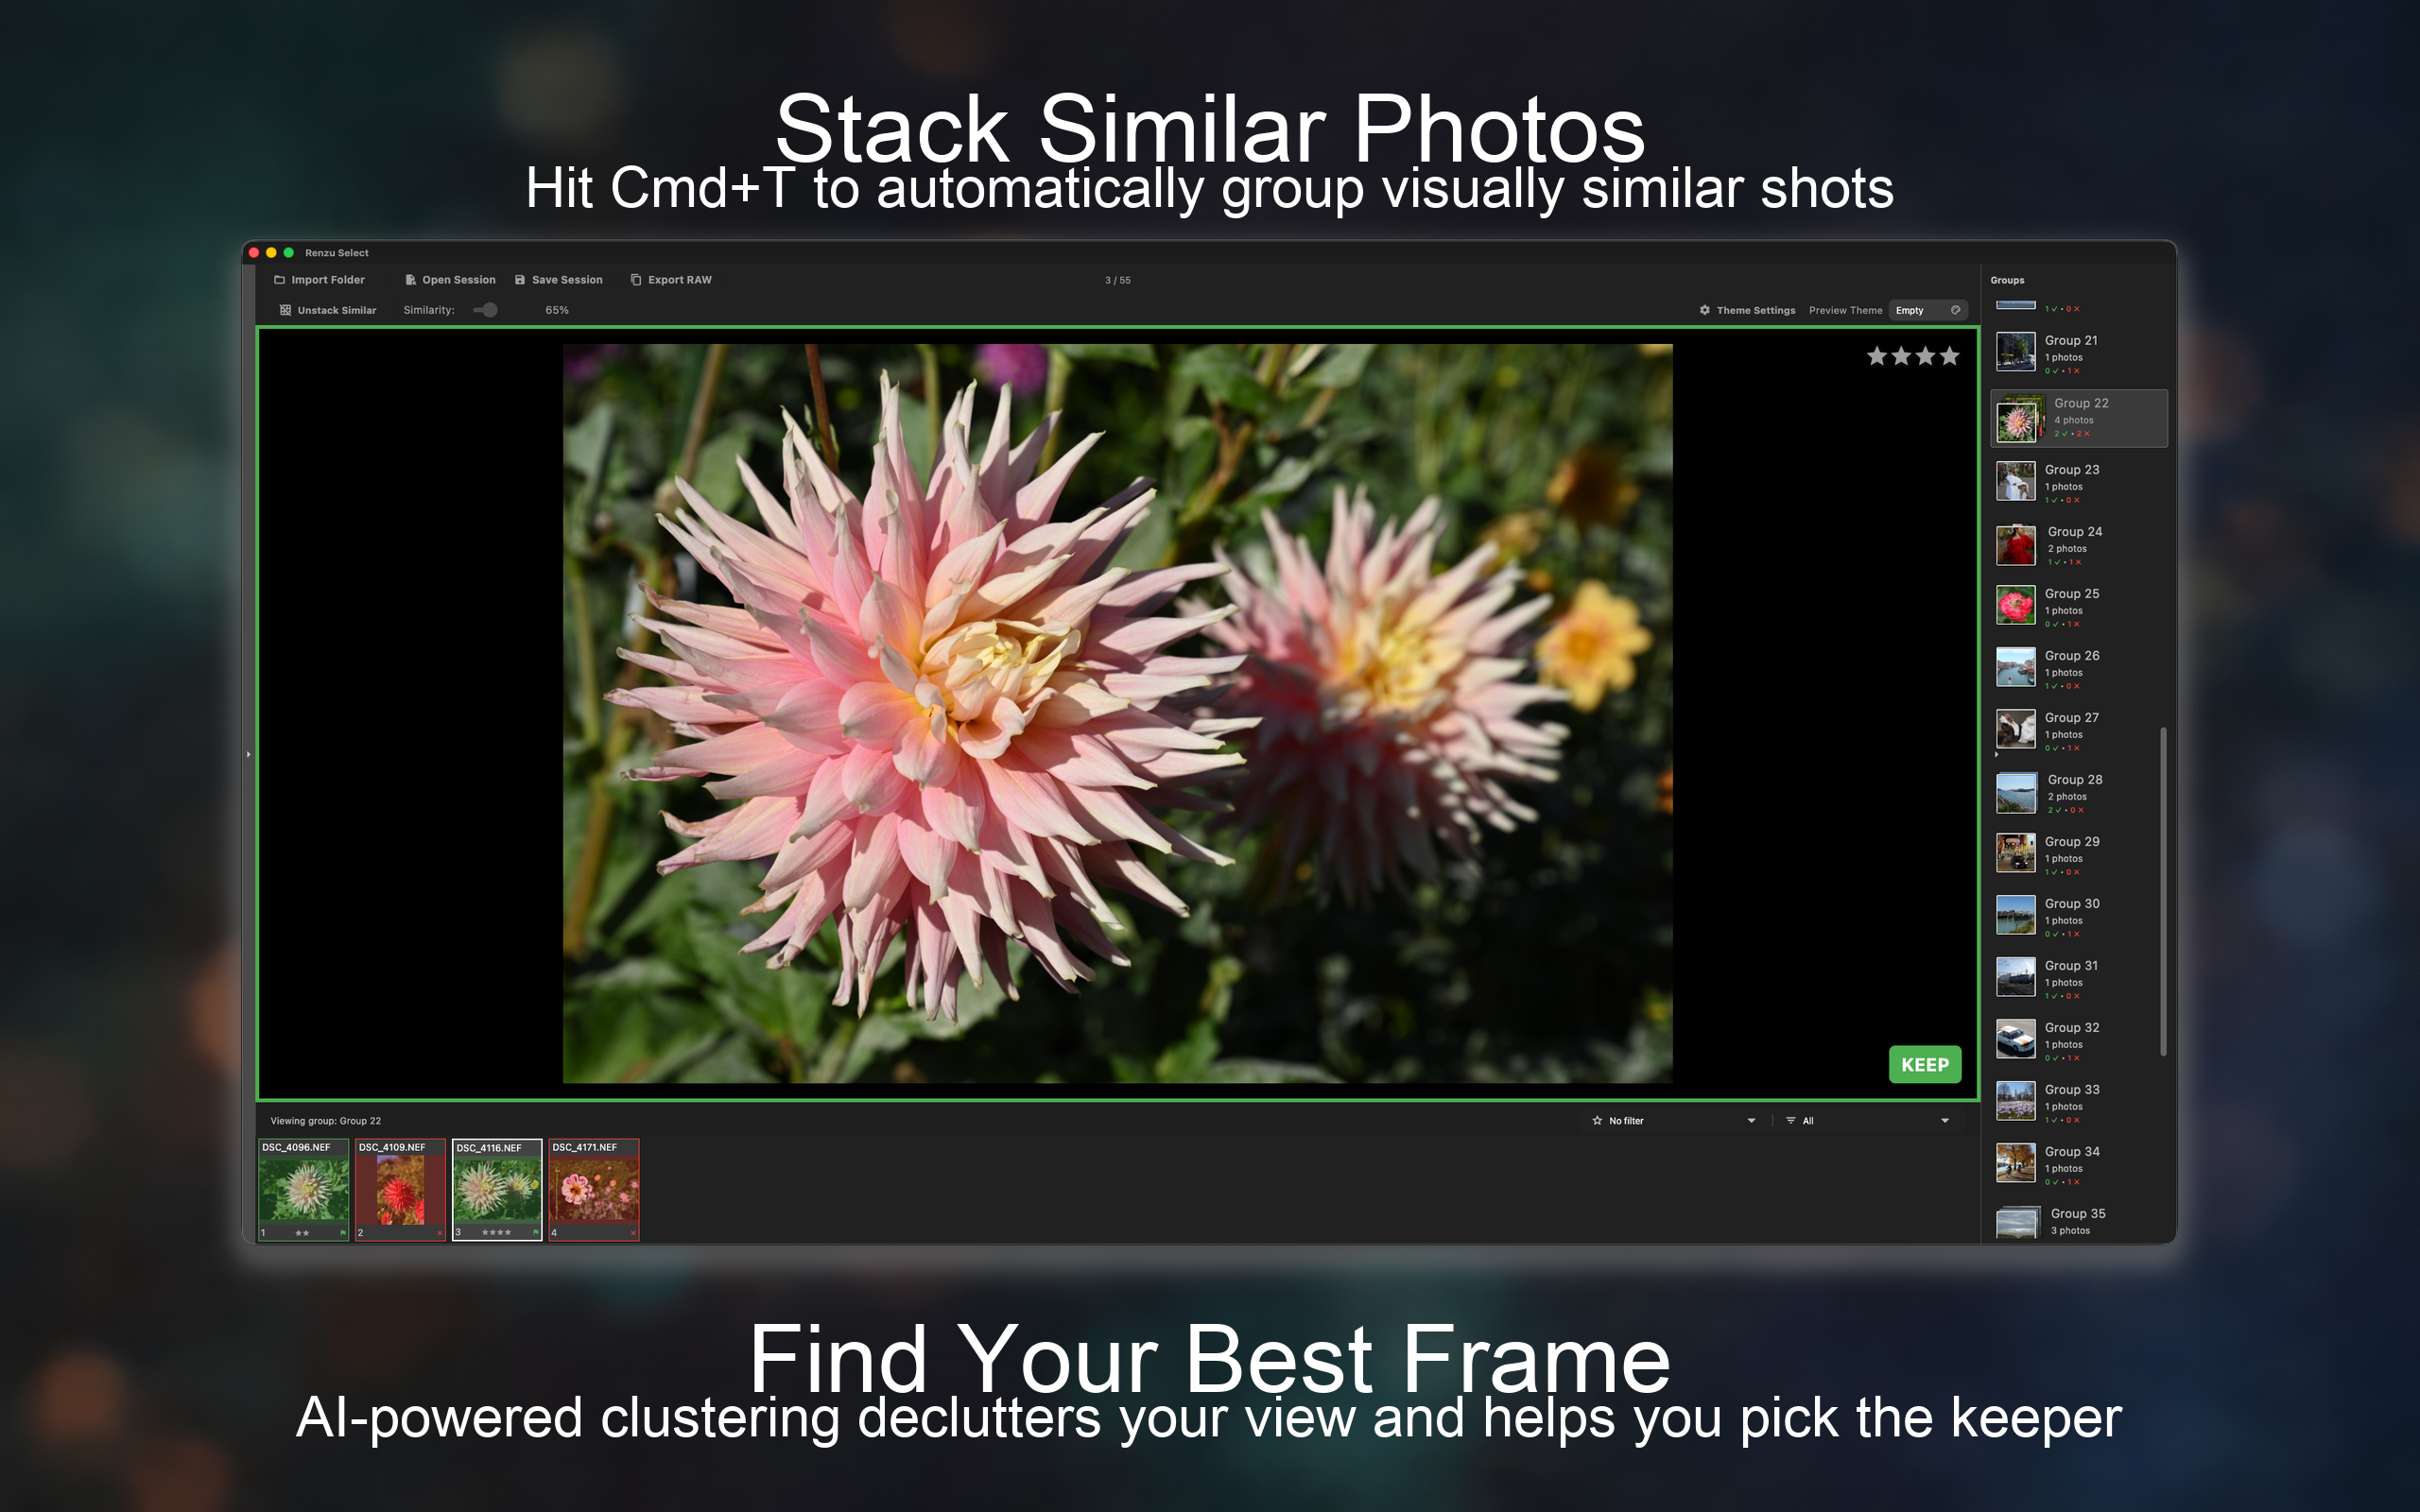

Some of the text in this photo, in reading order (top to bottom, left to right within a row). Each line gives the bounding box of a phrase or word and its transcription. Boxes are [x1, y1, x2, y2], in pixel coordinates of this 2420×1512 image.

[337, 249, 370, 258] Select
[291, 275, 366, 286] Import Folder
[422, 275, 496, 286] Open Session
[532, 275, 603, 284] Save Session
[648, 276, 713, 286] Export RAW
[1105, 275, 1132, 286] 3 / 55
[1990, 276, 2026, 286] Groups
[298, 306, 377, 315] Unstack Similar
[404, 305, 455, 317] Similarity:
[544, 306, 569, 315] 65%
[1717, 306, 1796, 317] Theme Settings
[1809, 306, 1883, 315] Preview Theme
[1895, 306, 1925, 317] Empty
[2045, 335, 2098, 348] Group 21
[2045, 352, 2083, 363] 1 photos
[2054, 398, 2109, 410] Group 22
[2054, 416, 2095, 426] 4 photos
[2045, 465, 2100, 477] Group 23
[2045, 482, 2083, 492] 1 photos
[2048, 526, 2103, 540] Group 24
[2048, 543, 2087, 555] 2 photos
[2045, 589, 2100, 601] Group 25
[2045, 606, 2083, 616] 1 photos
[2045, 650, 2100, 663] Group 26
[2045, 668, 2083, 679] 1 photos
[2045, 713, 2100, 726] Group 27
[2045, 730, 2083, 741] 1 photos
[2048, 775, 2103, 787] Group 28
[2048, 792, 2087, 802] 2 photos
[2045, 836, 2100, 850] Group 29
[2045, 854, 2083, 865] 1 photos
[2045, 899, 2100, 911] Group 30
[2045, 916, 2083, 926] 1 photos
[2045, 960, 2098, 973] Group 31
[2045, 978, 2083, 988] 1 photos
[2045, 1022, 2100, 1036] Group 32
[2045, 1040, 2083, 1051] 1 photos
[1901, 1057, 1950, 1073] KEEP
[2045, 1085, 2100, 1097] Group 33
[2045, 1102, 2083, 1112] 1 photos
[269, 1116, 382, 1127] Viewing group: Group 22
[1609, 1117, 1645, 1125] No filter
[1802, 1116, 1814, 1125] All
[262, 1143, 331, 1153] DSC_4096.NEF
[358, 1143, 426, 1153] DSC_4109.NEF
[457, 1144, 523, 1154] DSC_4116.NEF
[552, 1143, 617, 1153] DSC_4171.NEF
[2045, 1146, 2100, 1160] Group 34
[2045, 1164, 2083, 1175] 1 photos
[2050, 1209, 2106, 1221] Group 35
[260, 1228, 266, 1237] 1
[357, 1228, 364, 1237] 2
[455, 1228, 461, 1237] 3
[550, 1228, 558, 1237] 4
[2050, 1226, 2091, 1236] 3 photos
